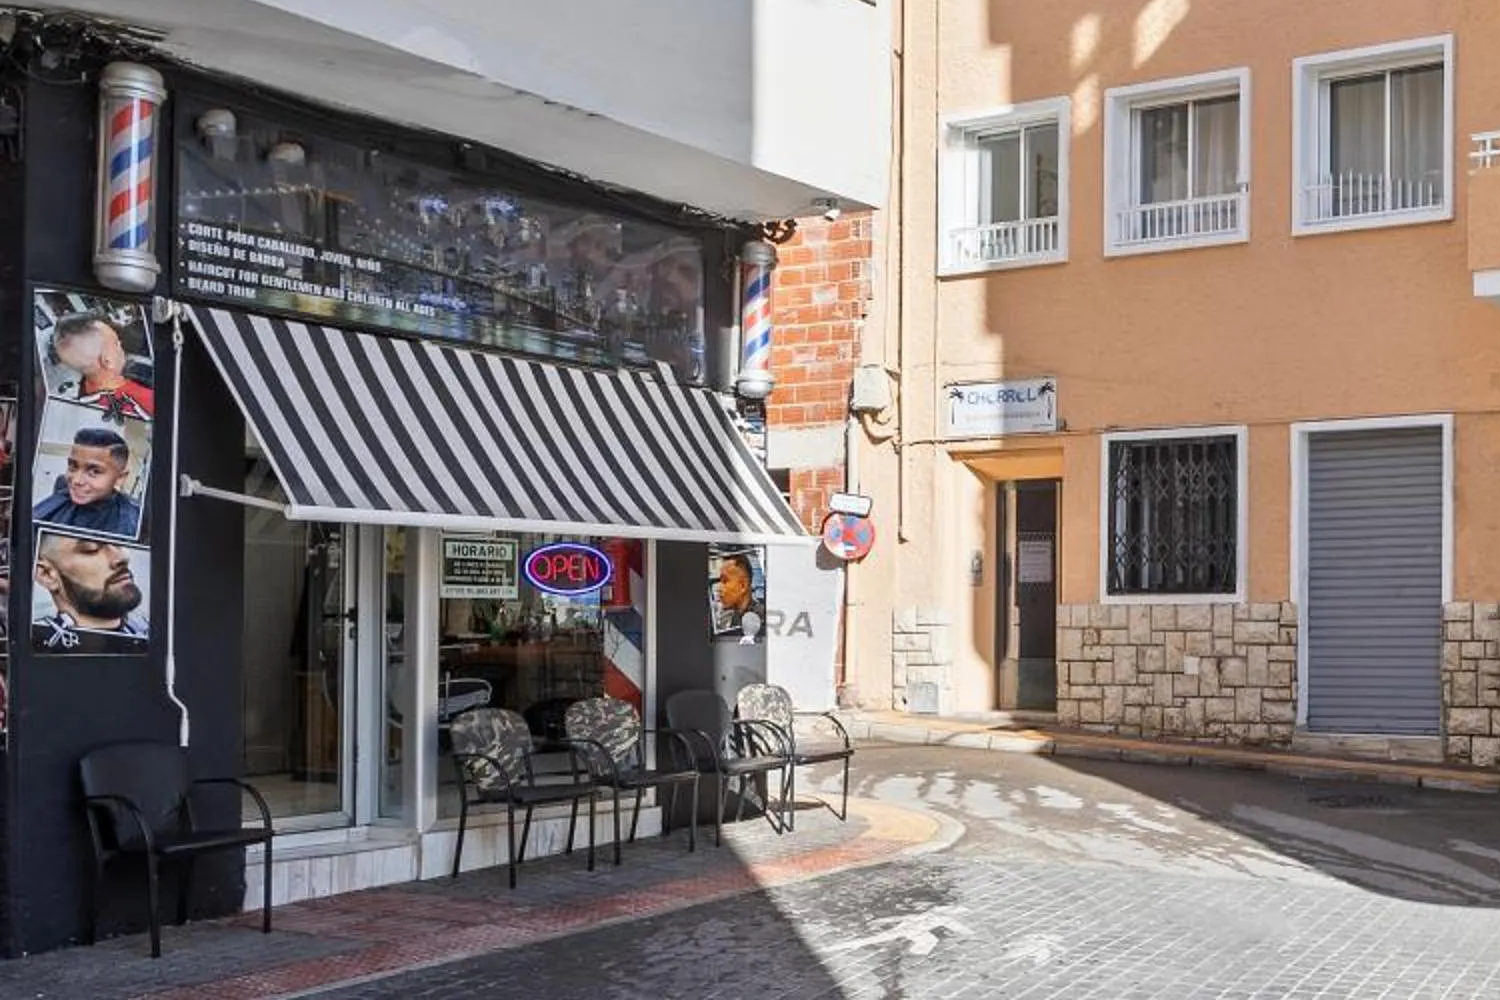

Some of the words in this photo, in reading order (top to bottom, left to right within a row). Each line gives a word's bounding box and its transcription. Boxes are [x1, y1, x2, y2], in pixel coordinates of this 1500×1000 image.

[187, 223, 223, 240] CORTE
[226, 230, 256, 246] PARA
[257, 236, 318, 260] CABALLERO,
[187, 239, 231, 257] DISEÑO
[233, 247, 246, 261] DE
[249, 251, 286, 268] BARBA
[187, 277, 225, 295] BEARD
[227, 284, 257, 299] TRIM
[187, 261, 236, 279] HAIRCUT
[239, 269, 259, 284] FOR
[261, 274, 322, 296] GENTLEMEN
[324, 285, 345, 299] AND
[347, 289, 393, 309] CHILDREN
[395, 299, 411, 313] ALL
[413, 303, 436, 317] AGES
[452, 543, 508, 558] HORARIO
[530, 553, 600, 582] OPEN
